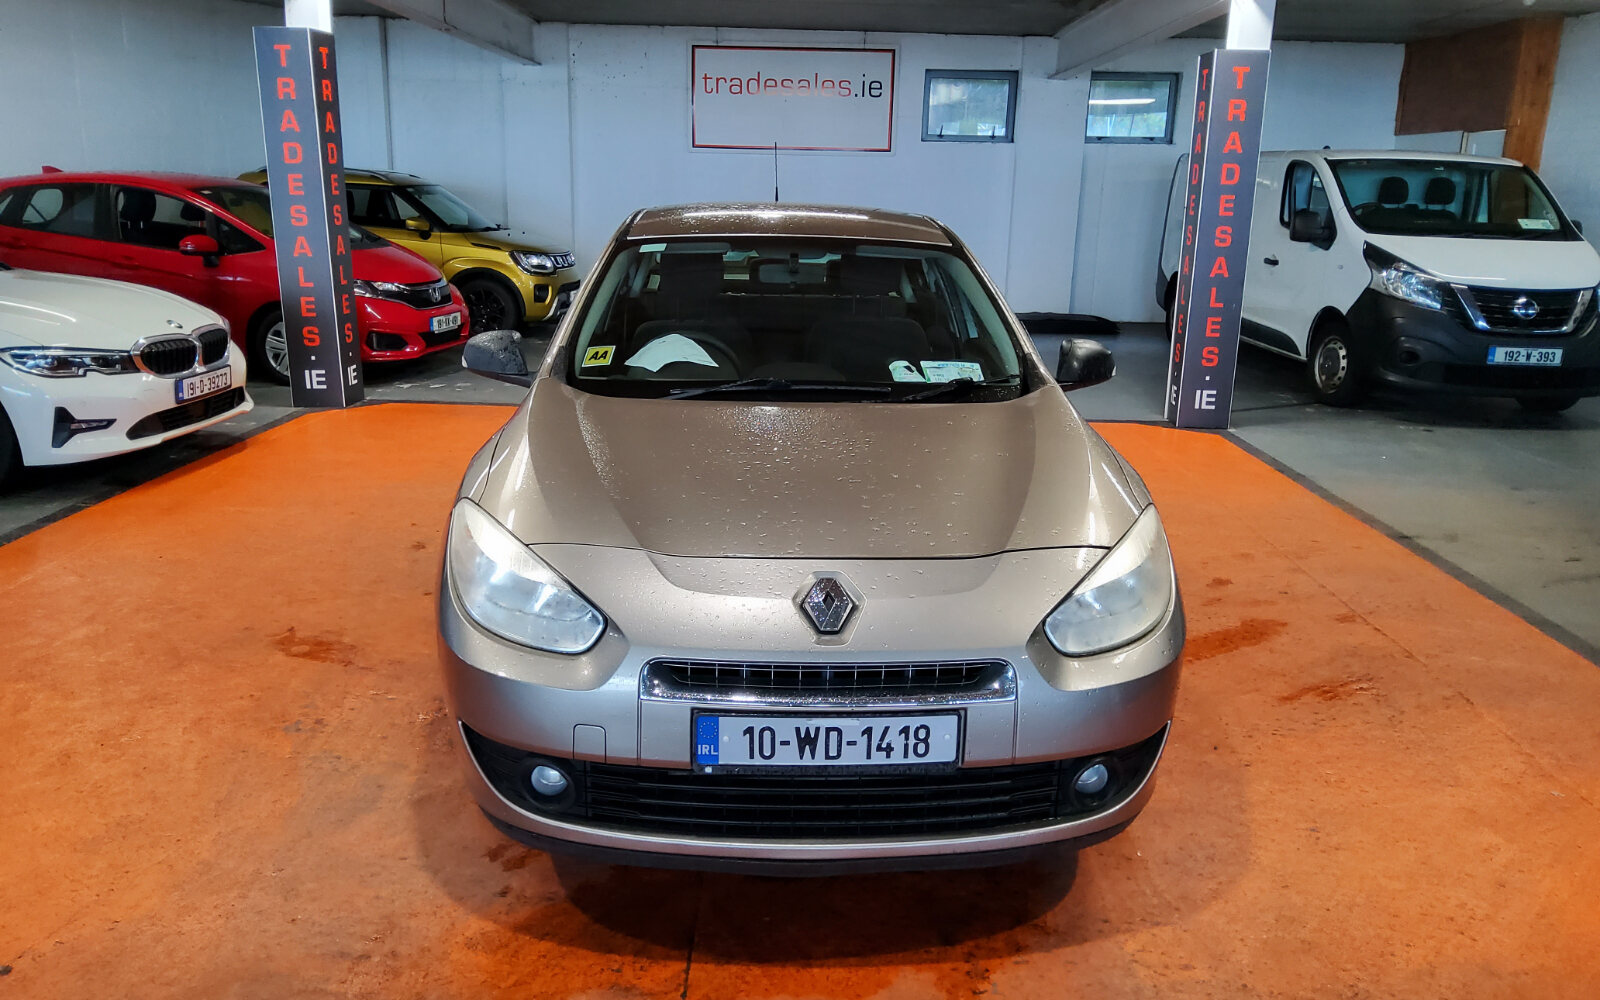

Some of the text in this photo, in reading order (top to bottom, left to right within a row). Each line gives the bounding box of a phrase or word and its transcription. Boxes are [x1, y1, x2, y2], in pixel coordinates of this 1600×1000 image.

[702, 71, 883, 98] tradesales.ie
[273, 44, 327, 390] TRADESALES.IE
[319, 46, 358, 387] TRADESALES.IE
[1194, 66, 1251, 410] TRADESALES.IE
[588, 350, 609, 361] AA
[1504, 350, 1557, 363] 192-W-393
[186, 372, 228, 398] 191-D-39273
[697, 744, 719, 756] IRL
[742, 723, 931, 760] 10-WD-1418
